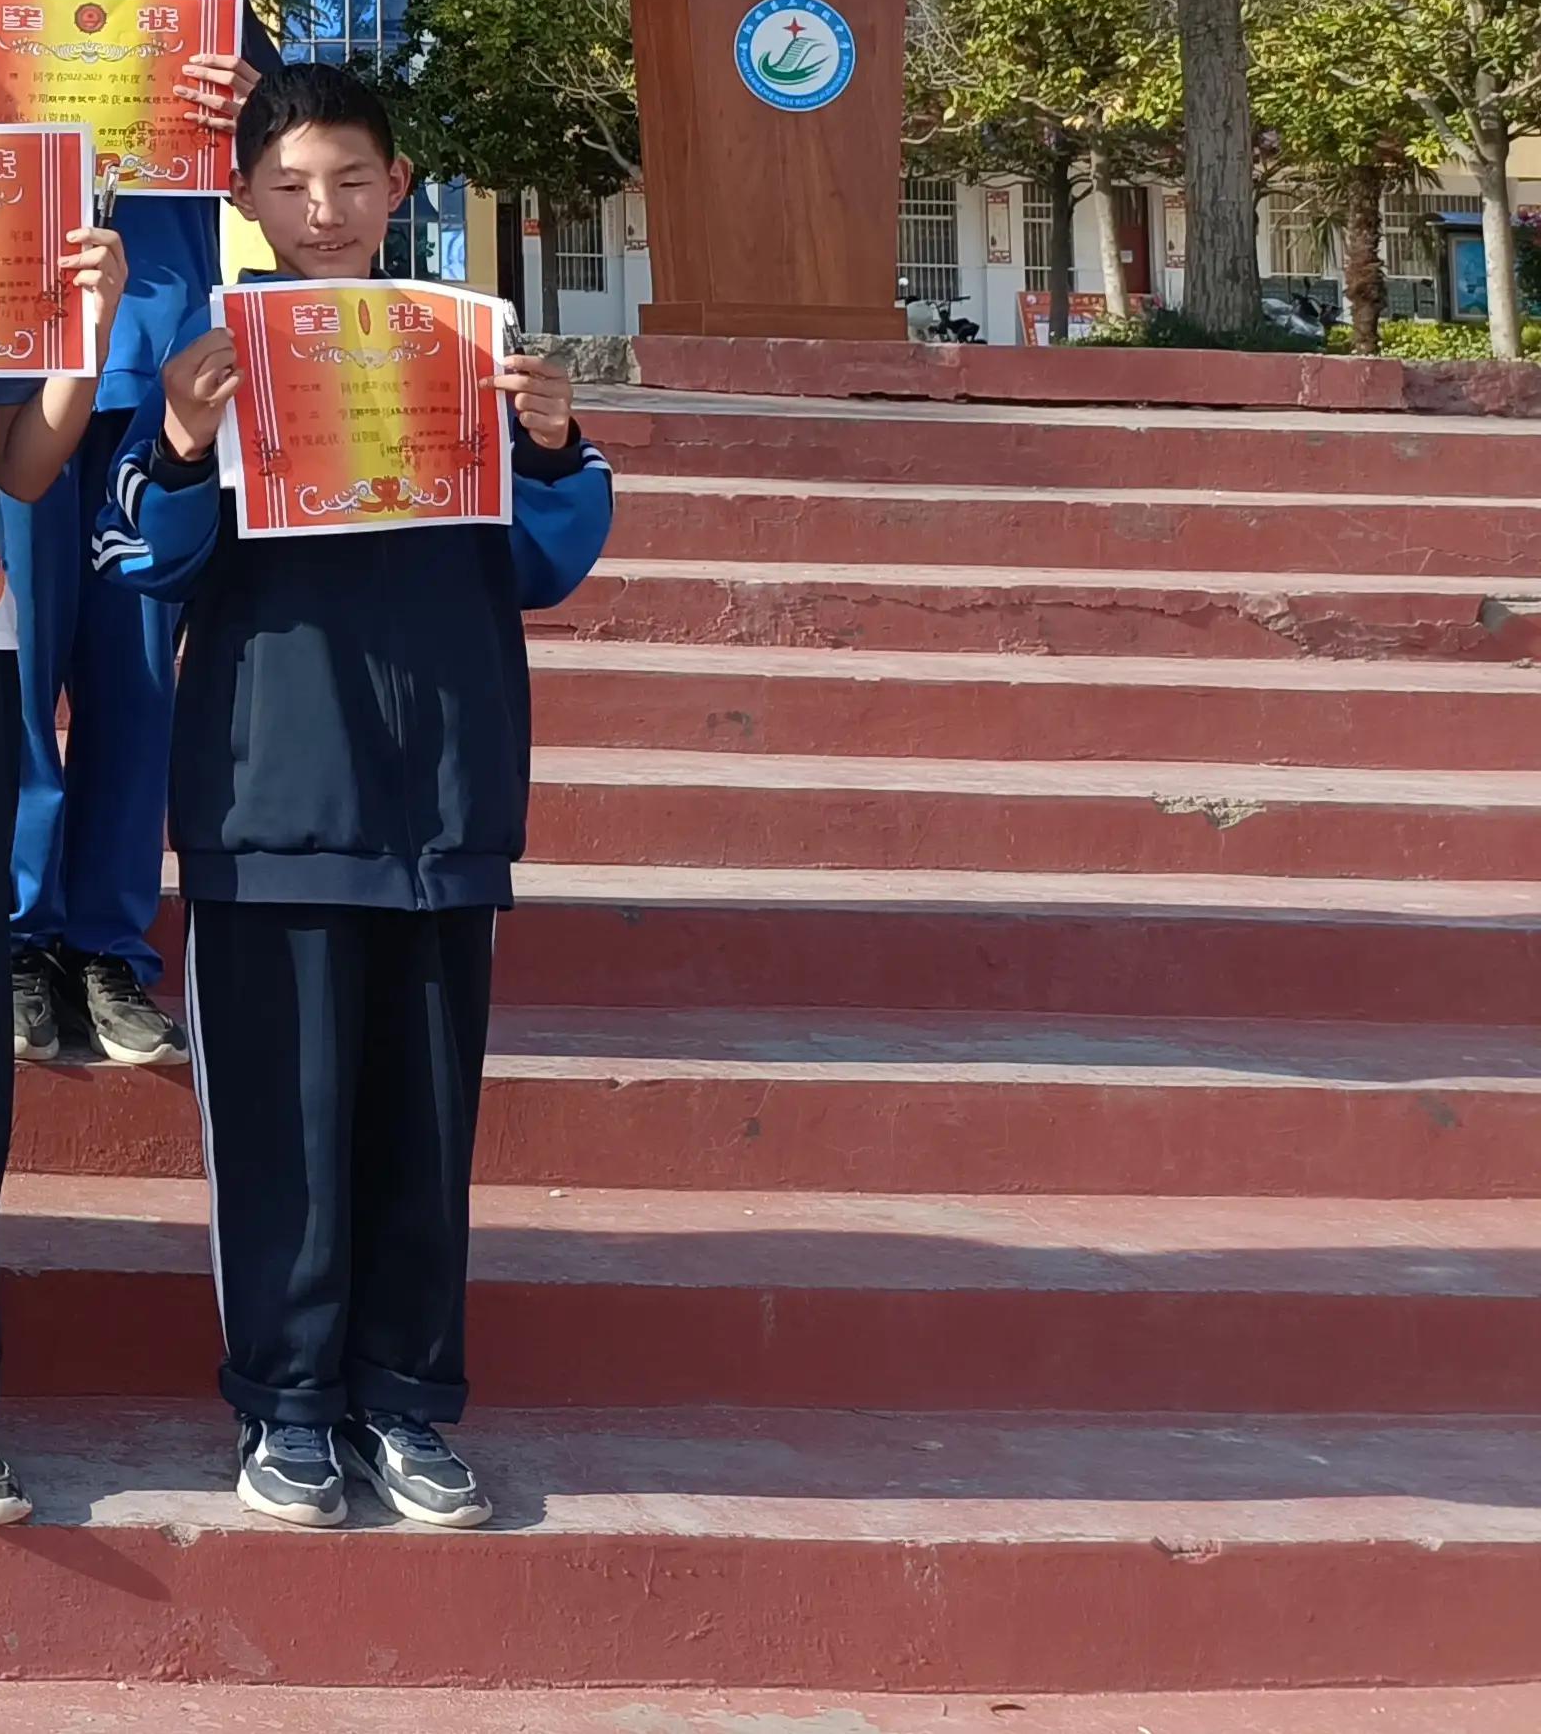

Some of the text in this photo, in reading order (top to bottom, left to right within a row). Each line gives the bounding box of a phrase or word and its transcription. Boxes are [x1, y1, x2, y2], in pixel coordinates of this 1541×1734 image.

[2, 5, 179, 32] 奖 状
[291, 303, 434, 335] 奖 状
